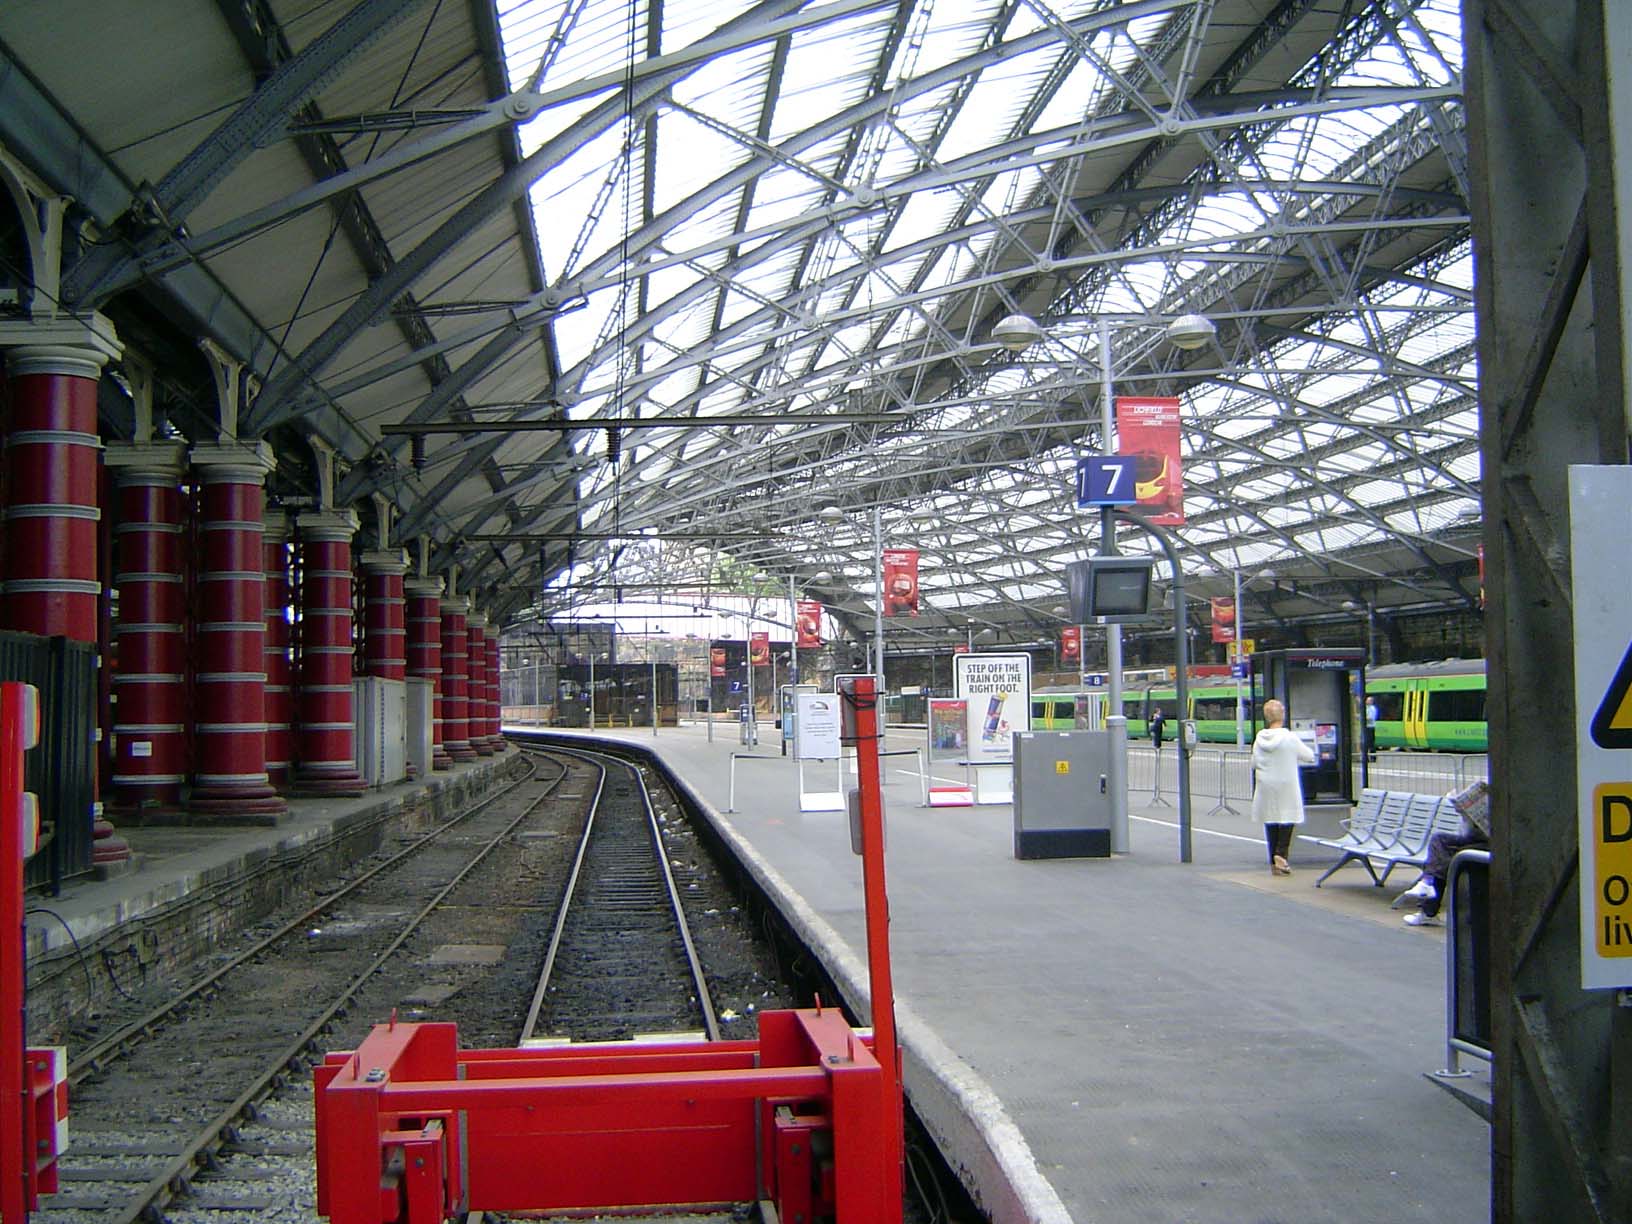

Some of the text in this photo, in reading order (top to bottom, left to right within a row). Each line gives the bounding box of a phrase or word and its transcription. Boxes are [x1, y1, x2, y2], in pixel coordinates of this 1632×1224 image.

[1101, 464, 1123, 495] 7
[967, 663, 1020, 673] STEP OFF THE
[1307, 658, 1345, 671] Telephone
[966, 673, 1021, 683] TRAIN ON THE
[733, 681, 740, 690] 7
[969, 683, 1019, 693] RIGHT FOOT.
